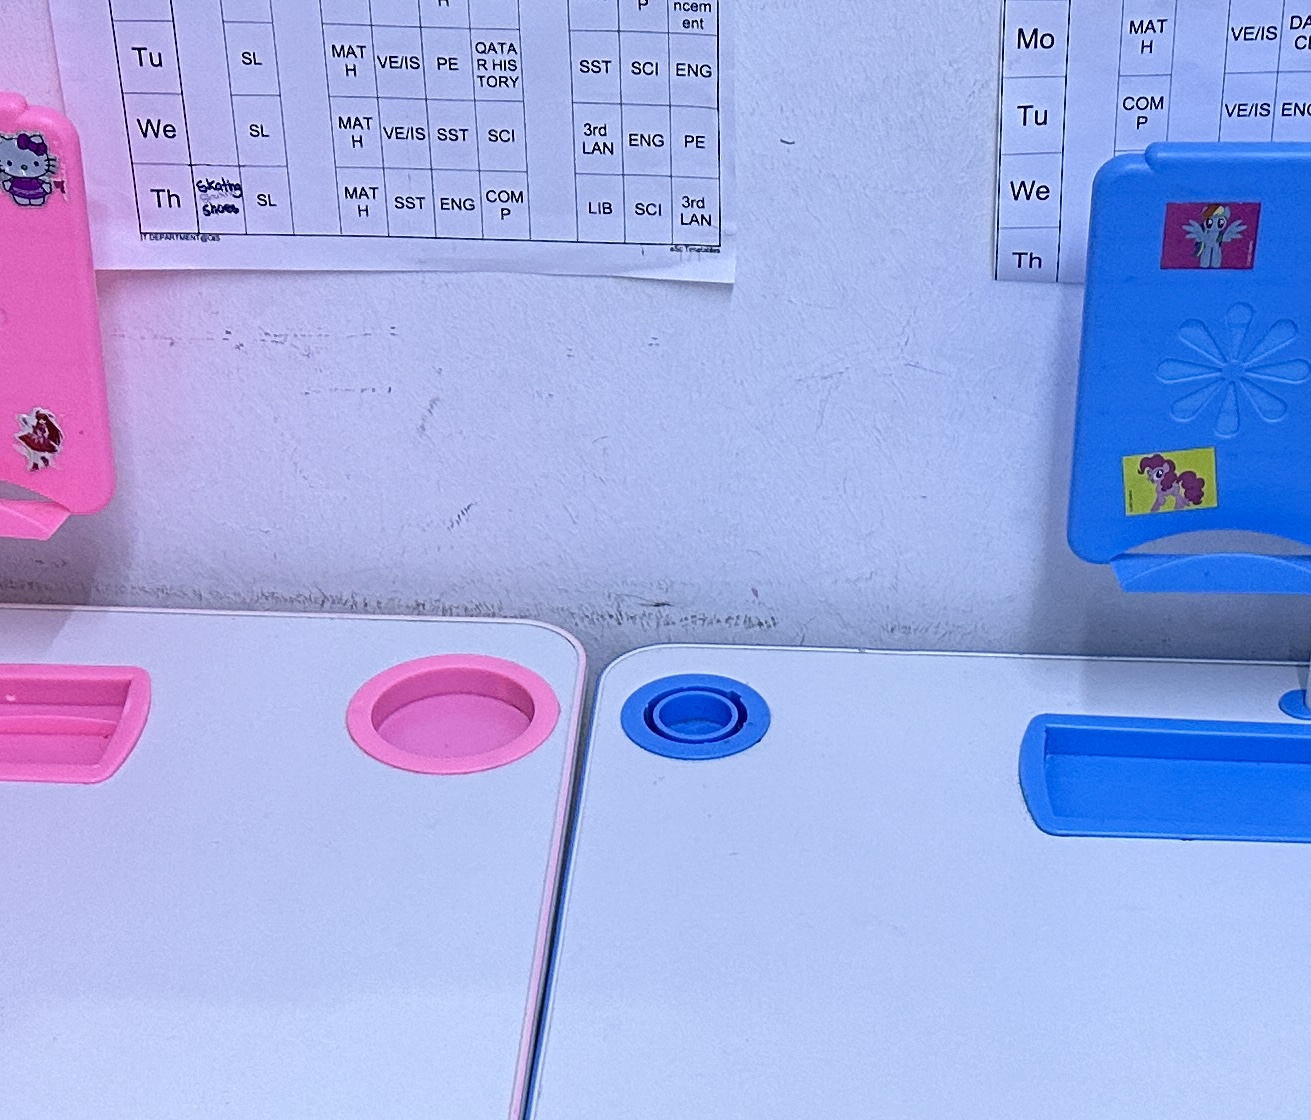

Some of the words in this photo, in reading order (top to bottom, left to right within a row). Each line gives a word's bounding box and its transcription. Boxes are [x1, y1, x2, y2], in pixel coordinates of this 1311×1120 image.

[673, 1, 712, 13] ncem
[682, 17, 704, 30] ent
[1129, 19, 1168, 34] MAT
[1017, 28, 1054, 49] Mo
[1231, 26, 1278, 41] VE/IS
[331, 44, 366, 58] MAT
[475, 42, 517, 55] QATA
[1141, 40, 1153, 54] H
[131, 47, 163, 67] Tu
[241, 52, 262, 65] SL
[377, 56, 420, 70] VE/IS
[345, 64, 357, 77] H
[437, 58, 459, 71] PE
[477, 59, 488, 72] R
[492, 59, 518, 72] HIS
[579, 60, 611, 73] SST
[631, 62, 659, 76] SCI
[676, 63, 712, 78] ENG
[477, 75, 519, 88] TORY
[1122, 96, 1164, 111] COM
[1017, 105, 1048, 126] Tu
[1225, 103, 1271, 118] VE/IS
[137, 119, 177, 138] We
[338, 117, 373, 130] MAT
[1137, 116, 1148, 130] P
[249, 124, 269, 137] SL
[383, 127, 426, 140] VE/IS
[437, 129, 468, 142] SST
[488, 129, 515, 143] SCI
[583, 123, 607, 137] 3rd
[352, 135, 363, 148] H
[628, 134, 665, 148] ENG
[684, 135, 706, 149] PE
[582, 142, 614, 155] LAN
[344, 187, 379, 200] MAT
[485, 190, 524, 204] COM
[1010, 180, 1050, 201] We
[150, 189, 181, 208] Th
[256, 195, 277, 207] SL
[394, 197, 425, 210] SST
[440, 198, 475, 211] ENG
[681, 196, 705, 209] 3rd
[358, 204, 369, 217] H
[500, 208, 511, 220] P
[588, 202, 613, 215] LIB
[634, 203, 662, 216] SCI
[680, 214, 712, 226] LAN
[1012, 252, 1042, 268] Th
